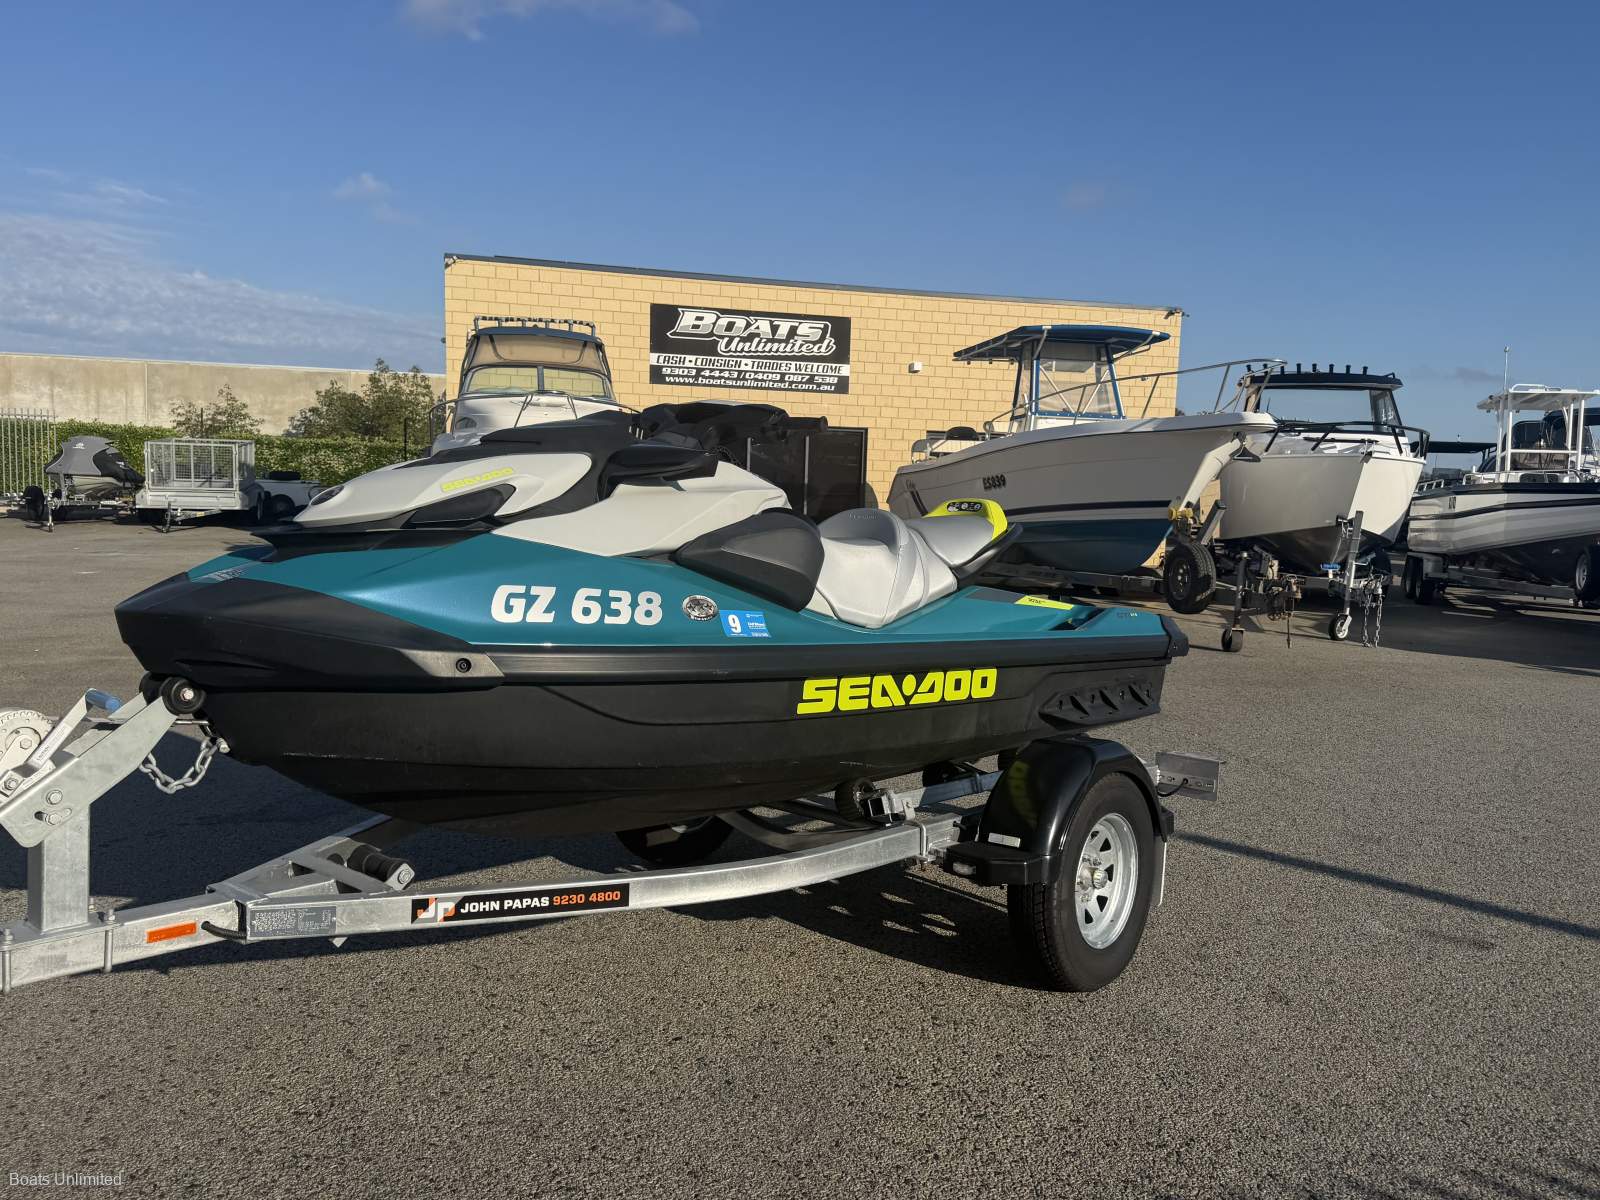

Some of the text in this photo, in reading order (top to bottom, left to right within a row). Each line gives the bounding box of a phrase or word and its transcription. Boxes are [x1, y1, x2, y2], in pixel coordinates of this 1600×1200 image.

[675, 310, 825, 341] BOATS
[719, 336, 835, 354] Unlimited
[656, 354, 843, 374] CASH CONSIGN TRADES WELCOME
[661, 367, 696, 376] 9303
[784, 374, 809, 382] 087
[813, 375, 839, 384] 538
[665, 376, 835, 391] www.boatsunlimited.com.au
[490, 584, 663, 626] GZ 638
[728, 614, 742, 634] 9
[460, 900, 500, 913] JOHN
[504, 896, 550, 910] PAPAS
[552, 893, 585, 906] 9230
[588, 890, 621, 903] 4800
